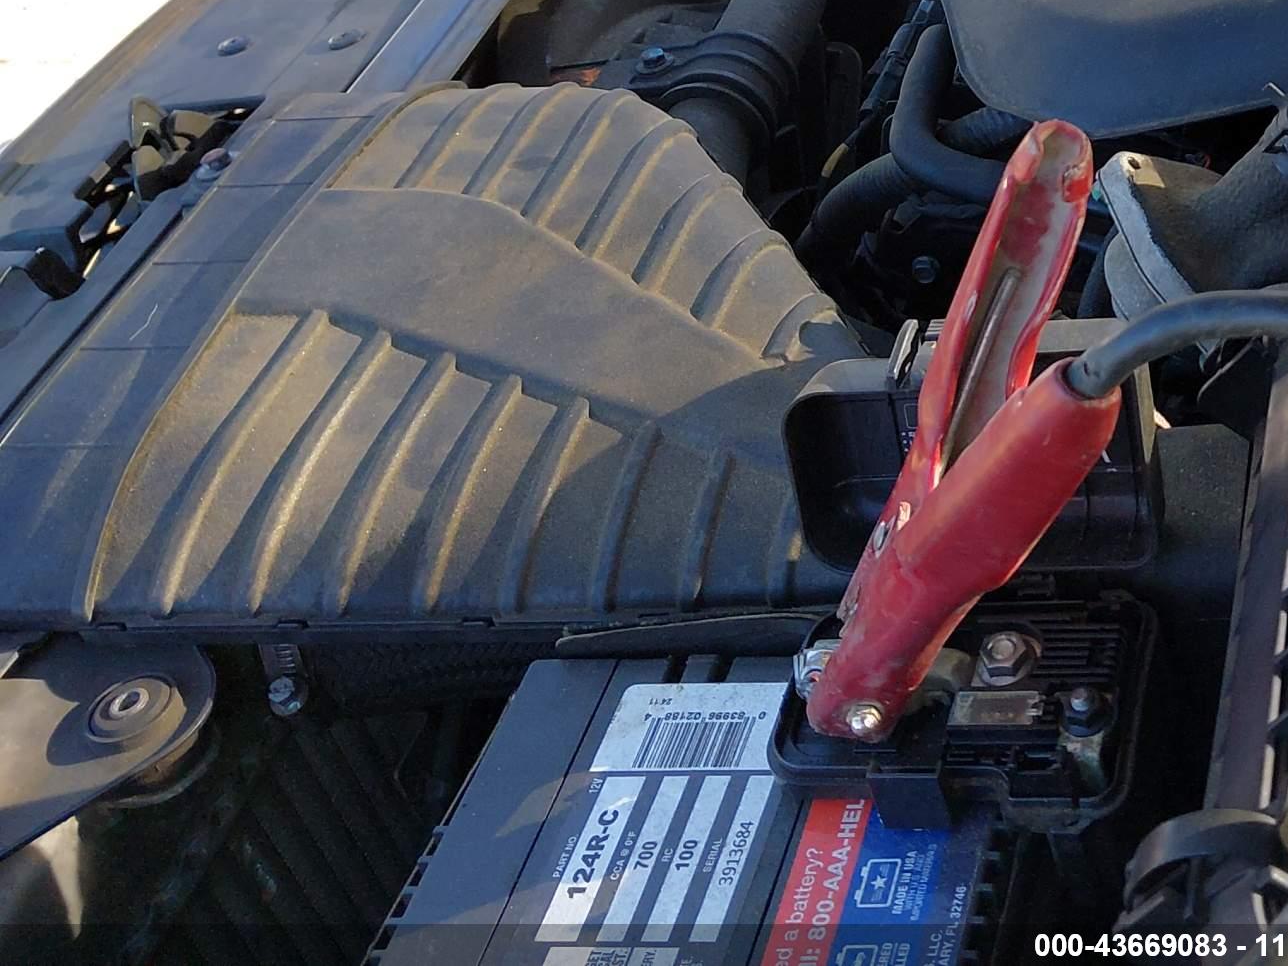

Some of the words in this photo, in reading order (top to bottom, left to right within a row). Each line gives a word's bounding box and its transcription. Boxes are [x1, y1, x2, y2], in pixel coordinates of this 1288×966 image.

[589, 777, 603, 793] 12V
[552, 852, 569, 878] PART
[567, 809, 619, 899] 124R-C
[633, 840, 658, 870] 700
[661, 848, 674, 863] RC
[675, 839, 698, 871] 100
[702, 837, 724, 873] SERIAL
[718, 820, 754, 887] 3913684
[904, 850, 918, 871] USA
[610, 859, 625, 881] CCA
[807, 799, 865, 941] 800-AAA-HEL
[901, 872, 912, 884] IN
[785, 847, 824, 925] battery?
[892, 886, 909, 915] MADE
[785, 929, 799, 942] a
[938, 940, 957, 966] ARY,
